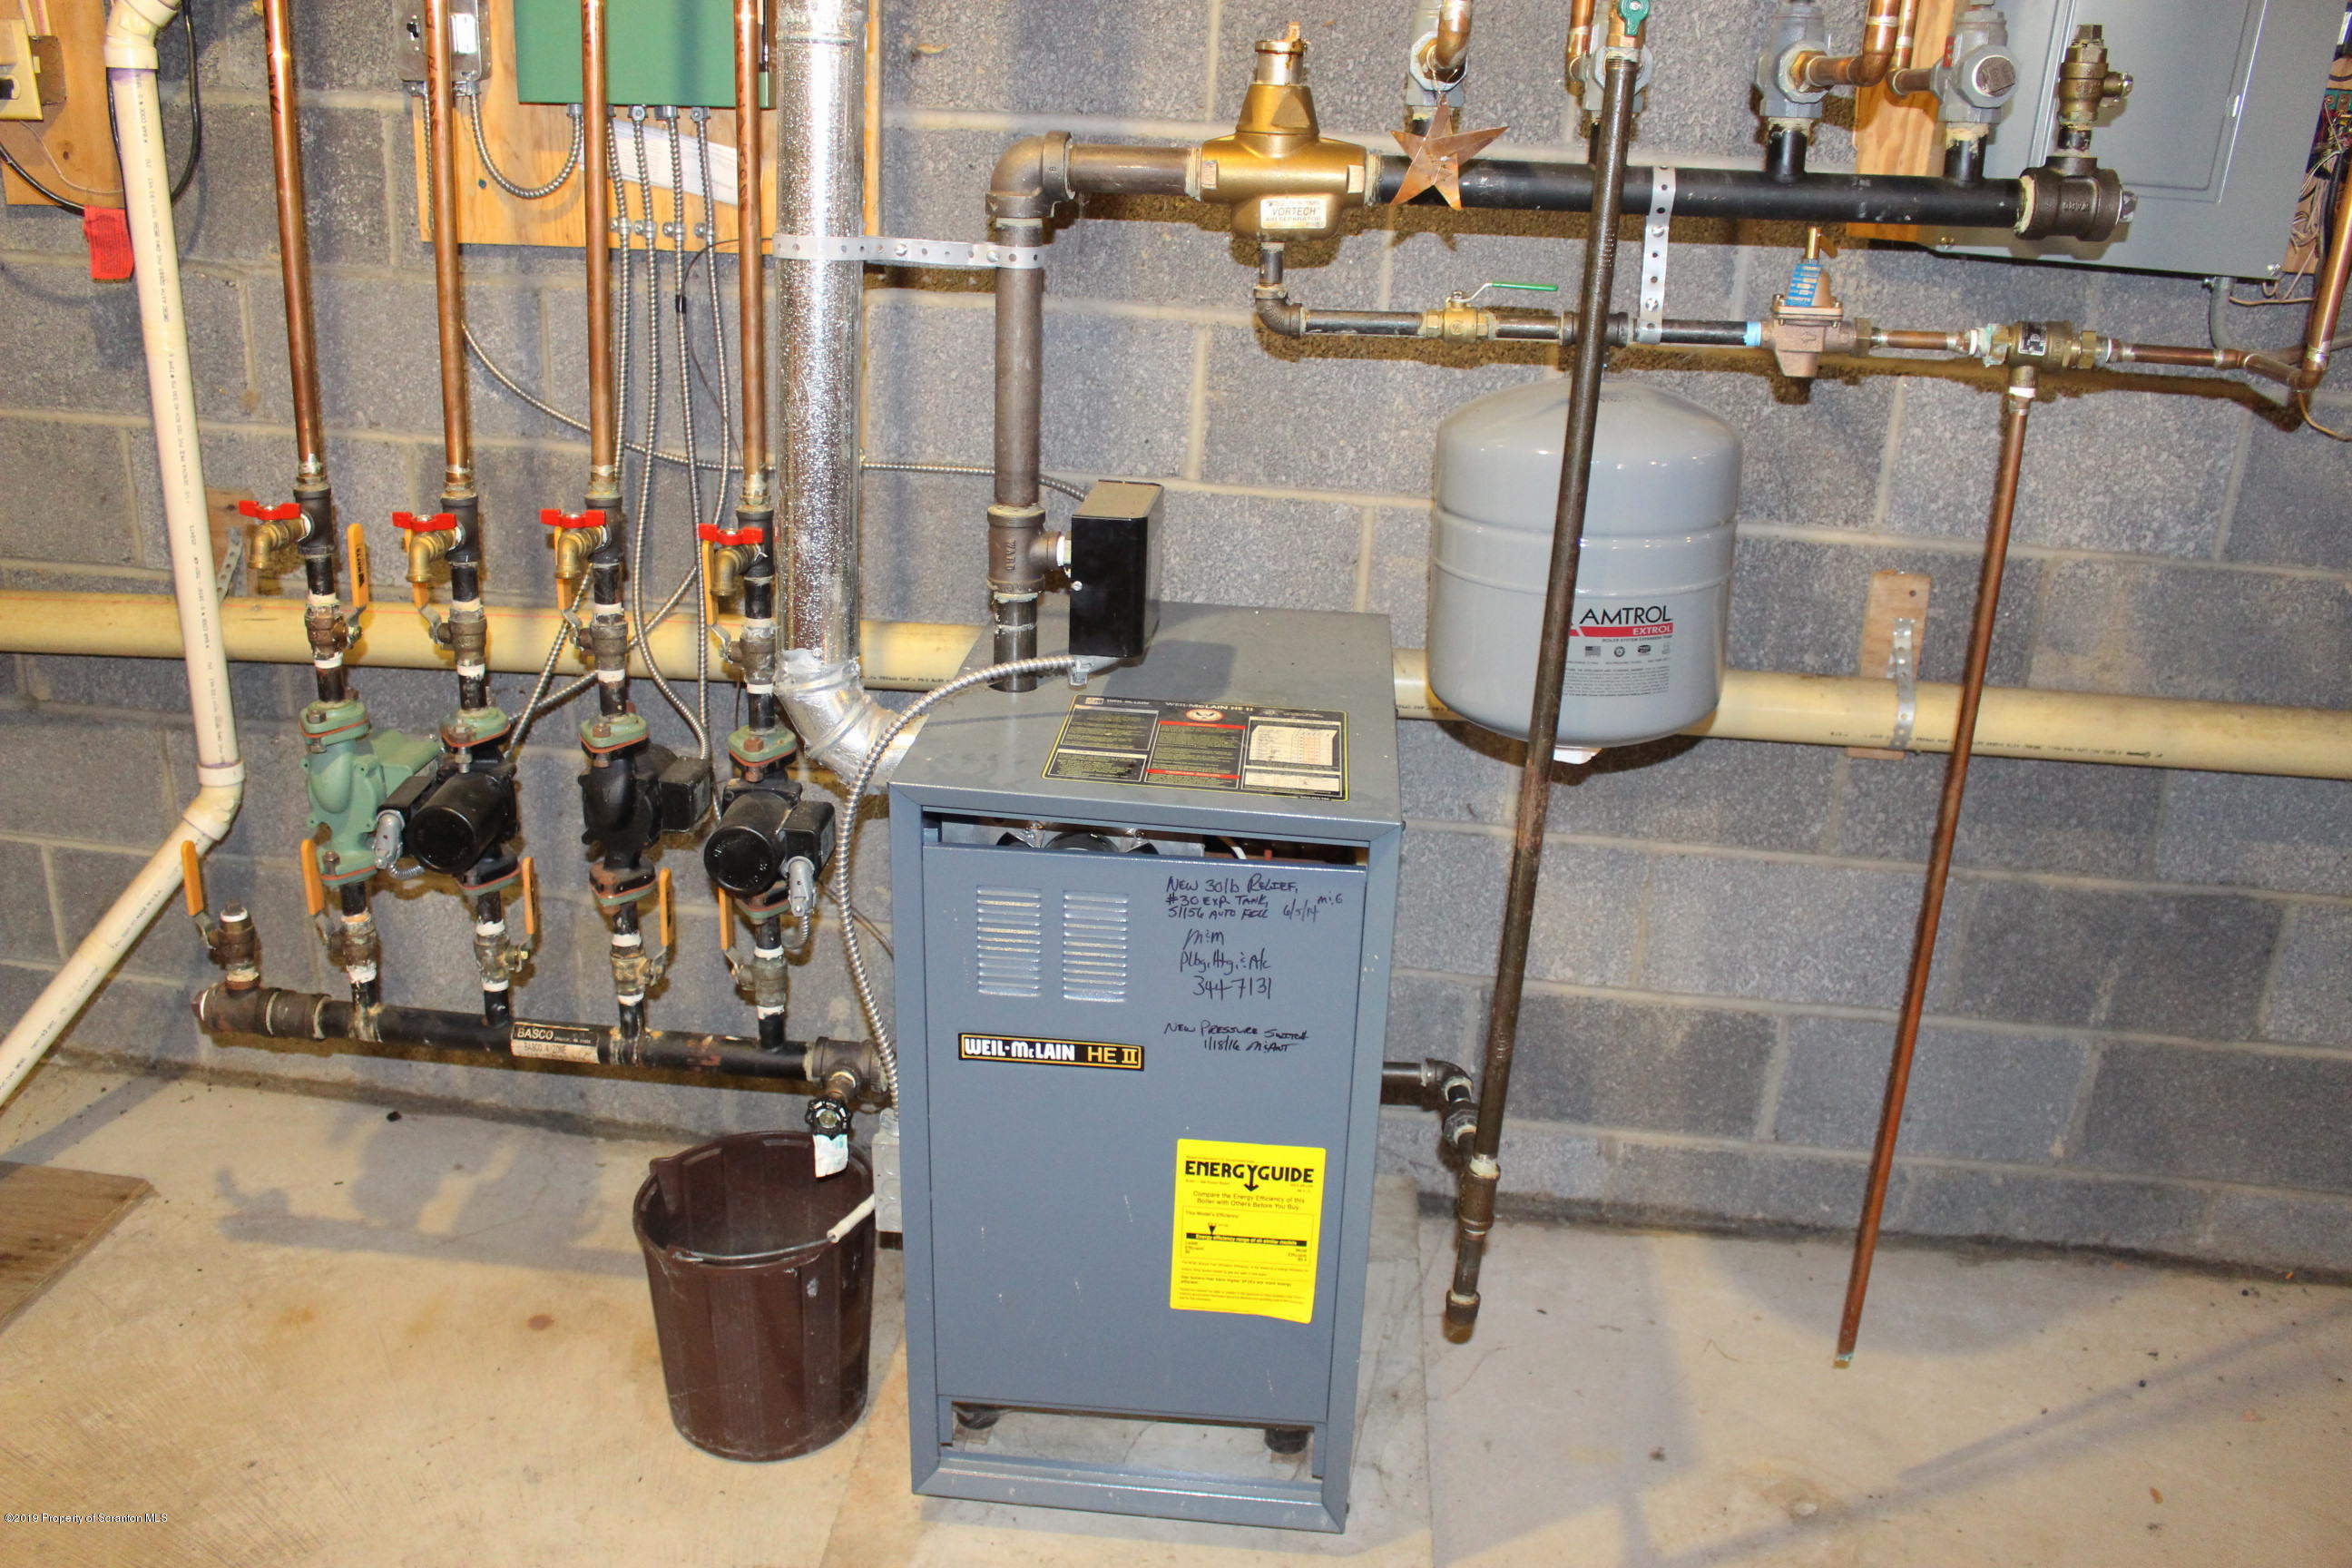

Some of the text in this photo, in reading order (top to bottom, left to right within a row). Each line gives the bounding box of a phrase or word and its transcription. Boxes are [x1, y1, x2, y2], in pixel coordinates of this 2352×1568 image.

[1272, 206, 1317, 216] VORTECH
[1580, 605, 1673, 625] AMTROL
[1633, 624, 1671, 635] EXTROL
[1192, 975, 1272, 1001] 344-7131
[517, 1027, 554, 1041] BASCO
[1087, 1046, 1118, 1063] HE
[1122, 1049, 1138, 1064] II
[1185, 1160, 1315, 1191] ENERGYGUIDE
[1192, 1190, 1220, 1199] Compare
[1221, 1191, 1231, 1199] the
[1234, 1191, 1254, 1201] Energy
[1256, 1194, 1284, 1203] Efficiency
[1230, 1199, 1251, 1208] Others
[1253, 1200, 1273, 1209] Before
[1288, 1202, 1299, 1211] Buy
